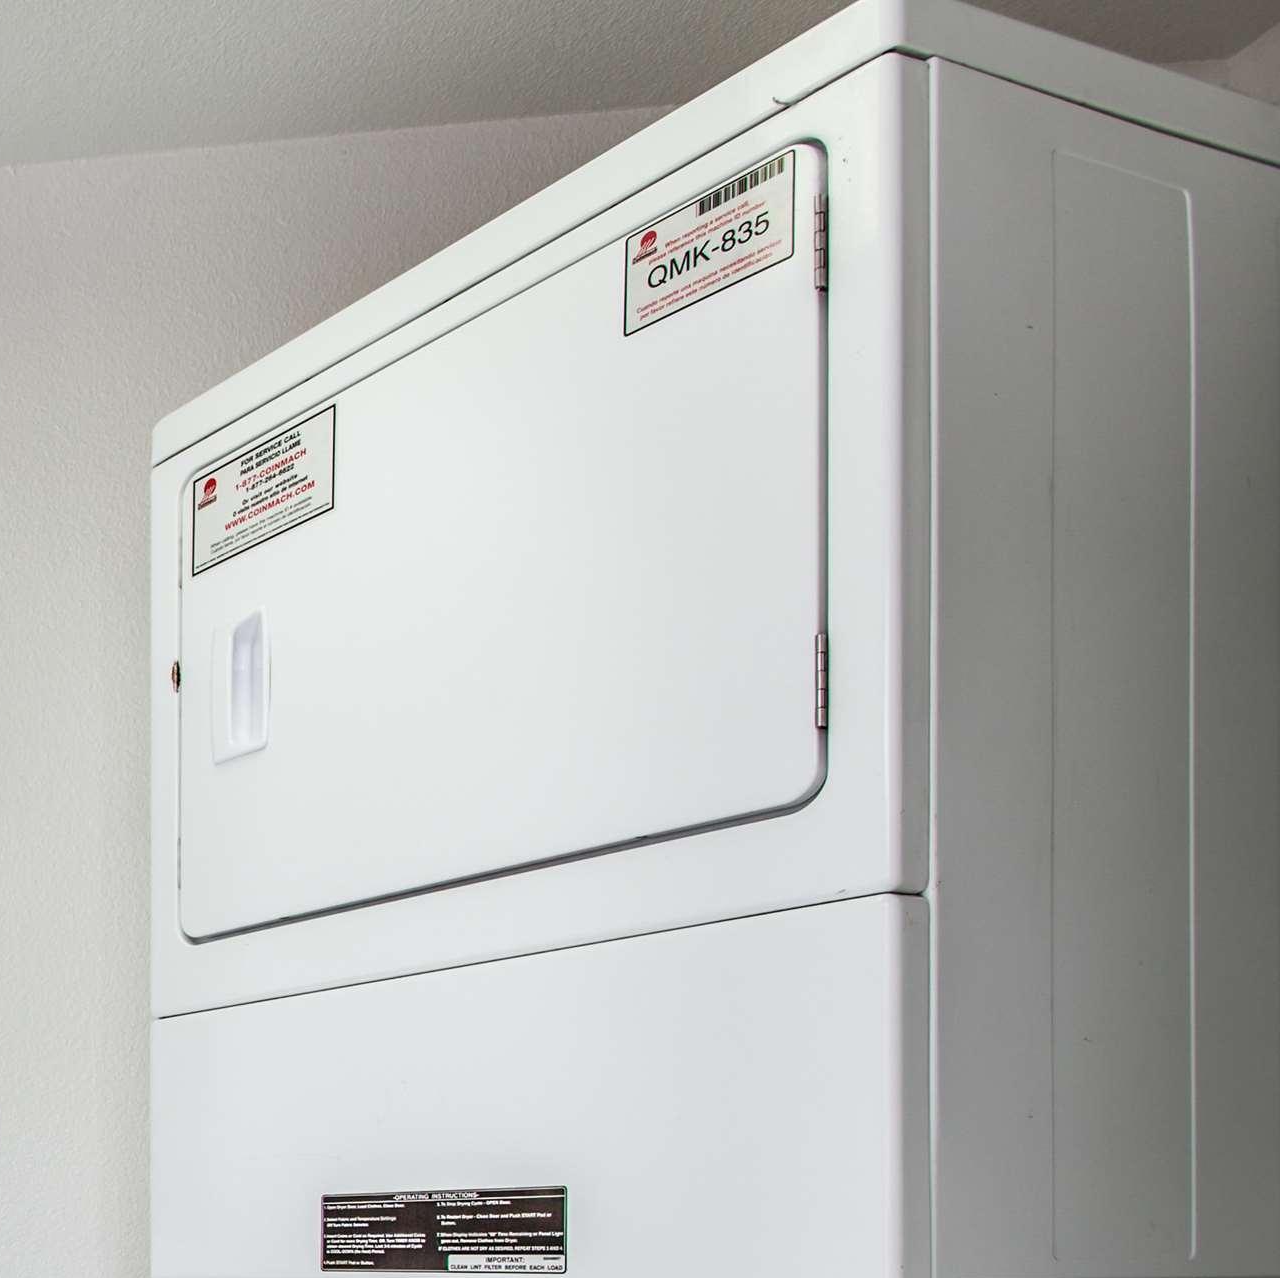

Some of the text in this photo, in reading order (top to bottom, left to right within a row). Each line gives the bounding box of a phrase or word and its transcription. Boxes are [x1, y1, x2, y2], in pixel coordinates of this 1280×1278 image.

[647, 210, 769, 288] QMK-835
[240, 430, 300, 466] FOR SERVICE CALL
[240, 439, 300, 475] PARA SERVICIO LLAME
[235, 447, 306, 490] 1-877-COINMACH
[224, 480, 314, 530] WWW.COINMACH.COM
[485, 1256, 525, 1264] IMPORTANT:
